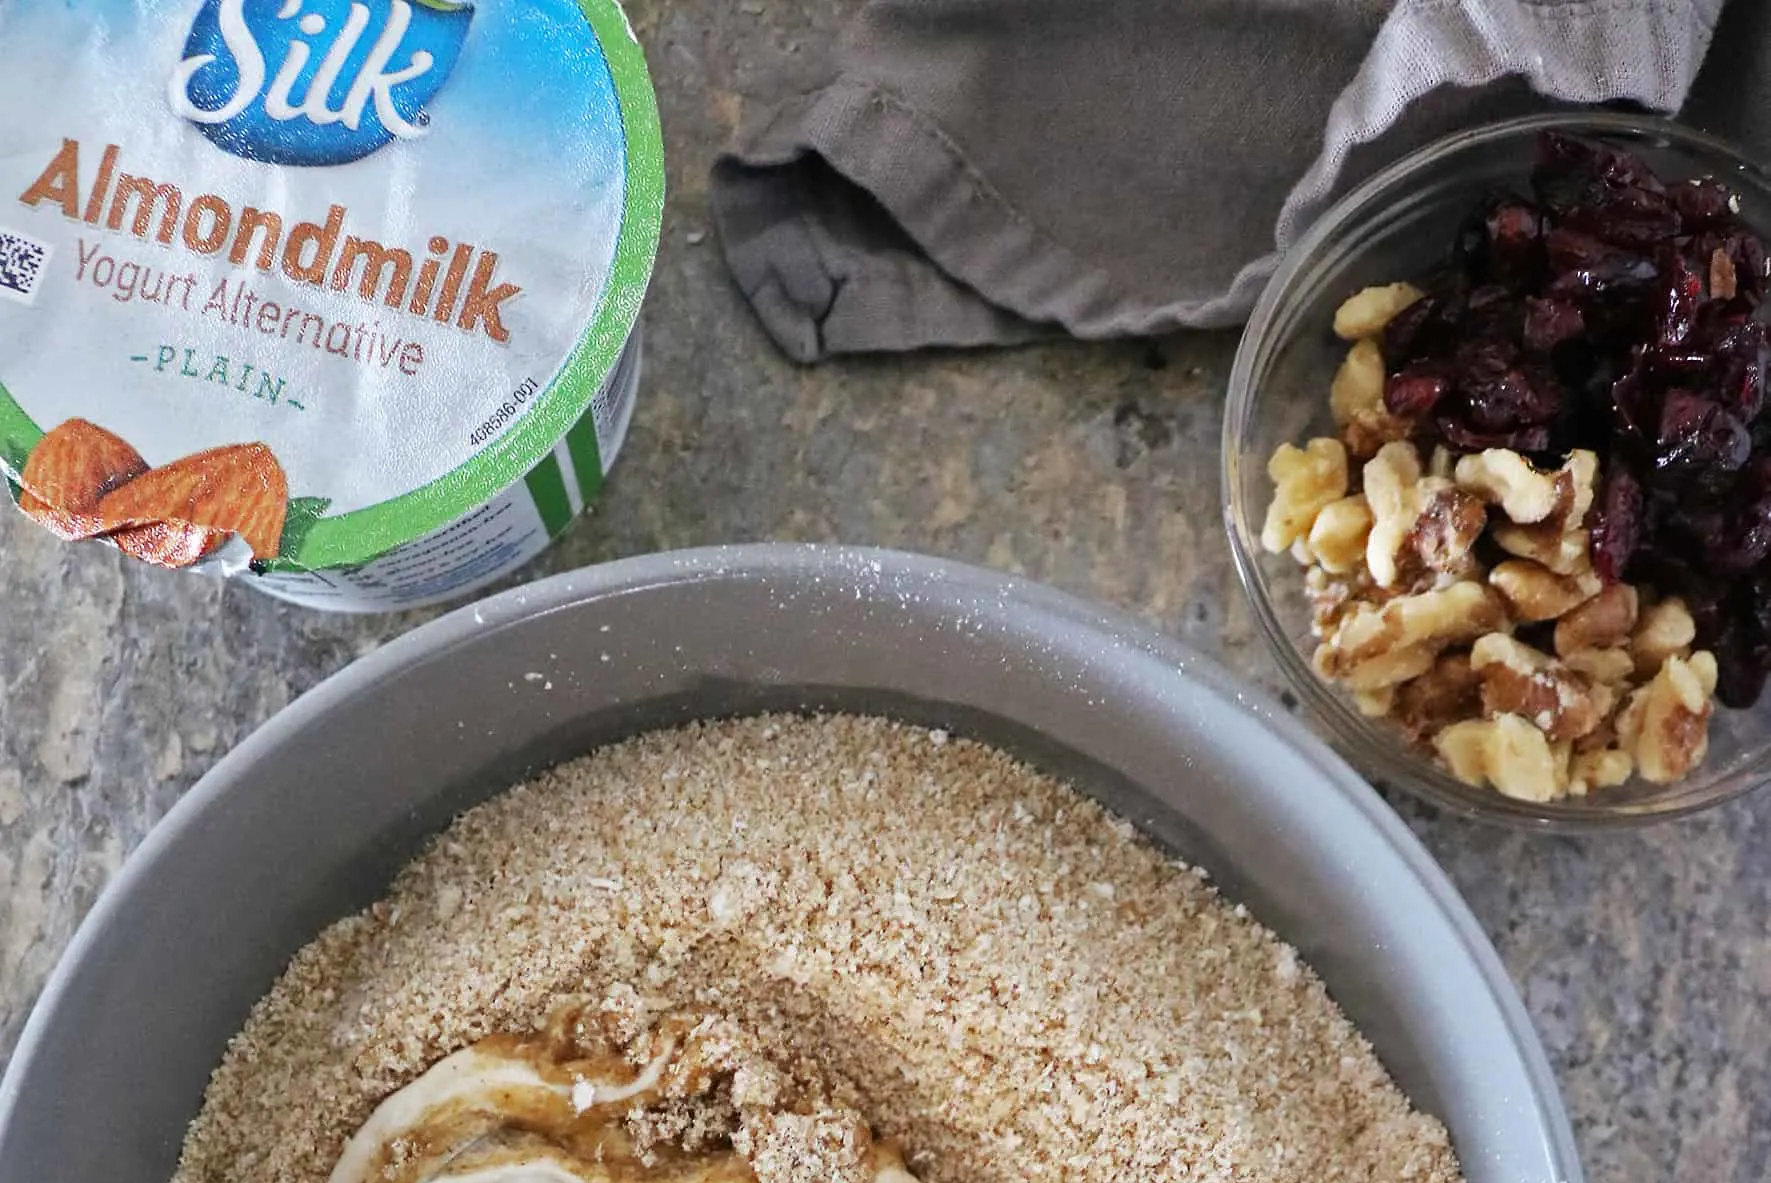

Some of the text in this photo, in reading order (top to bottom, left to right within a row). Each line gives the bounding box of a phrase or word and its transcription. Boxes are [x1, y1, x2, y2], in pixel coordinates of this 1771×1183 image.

[168, 0, 433, 140] Silk
[18, 137, 523, 343] Almondmilk
[75, 238, 424, 376] Yogurt Alternative
[469, 376, 539, 447] 408586-001
